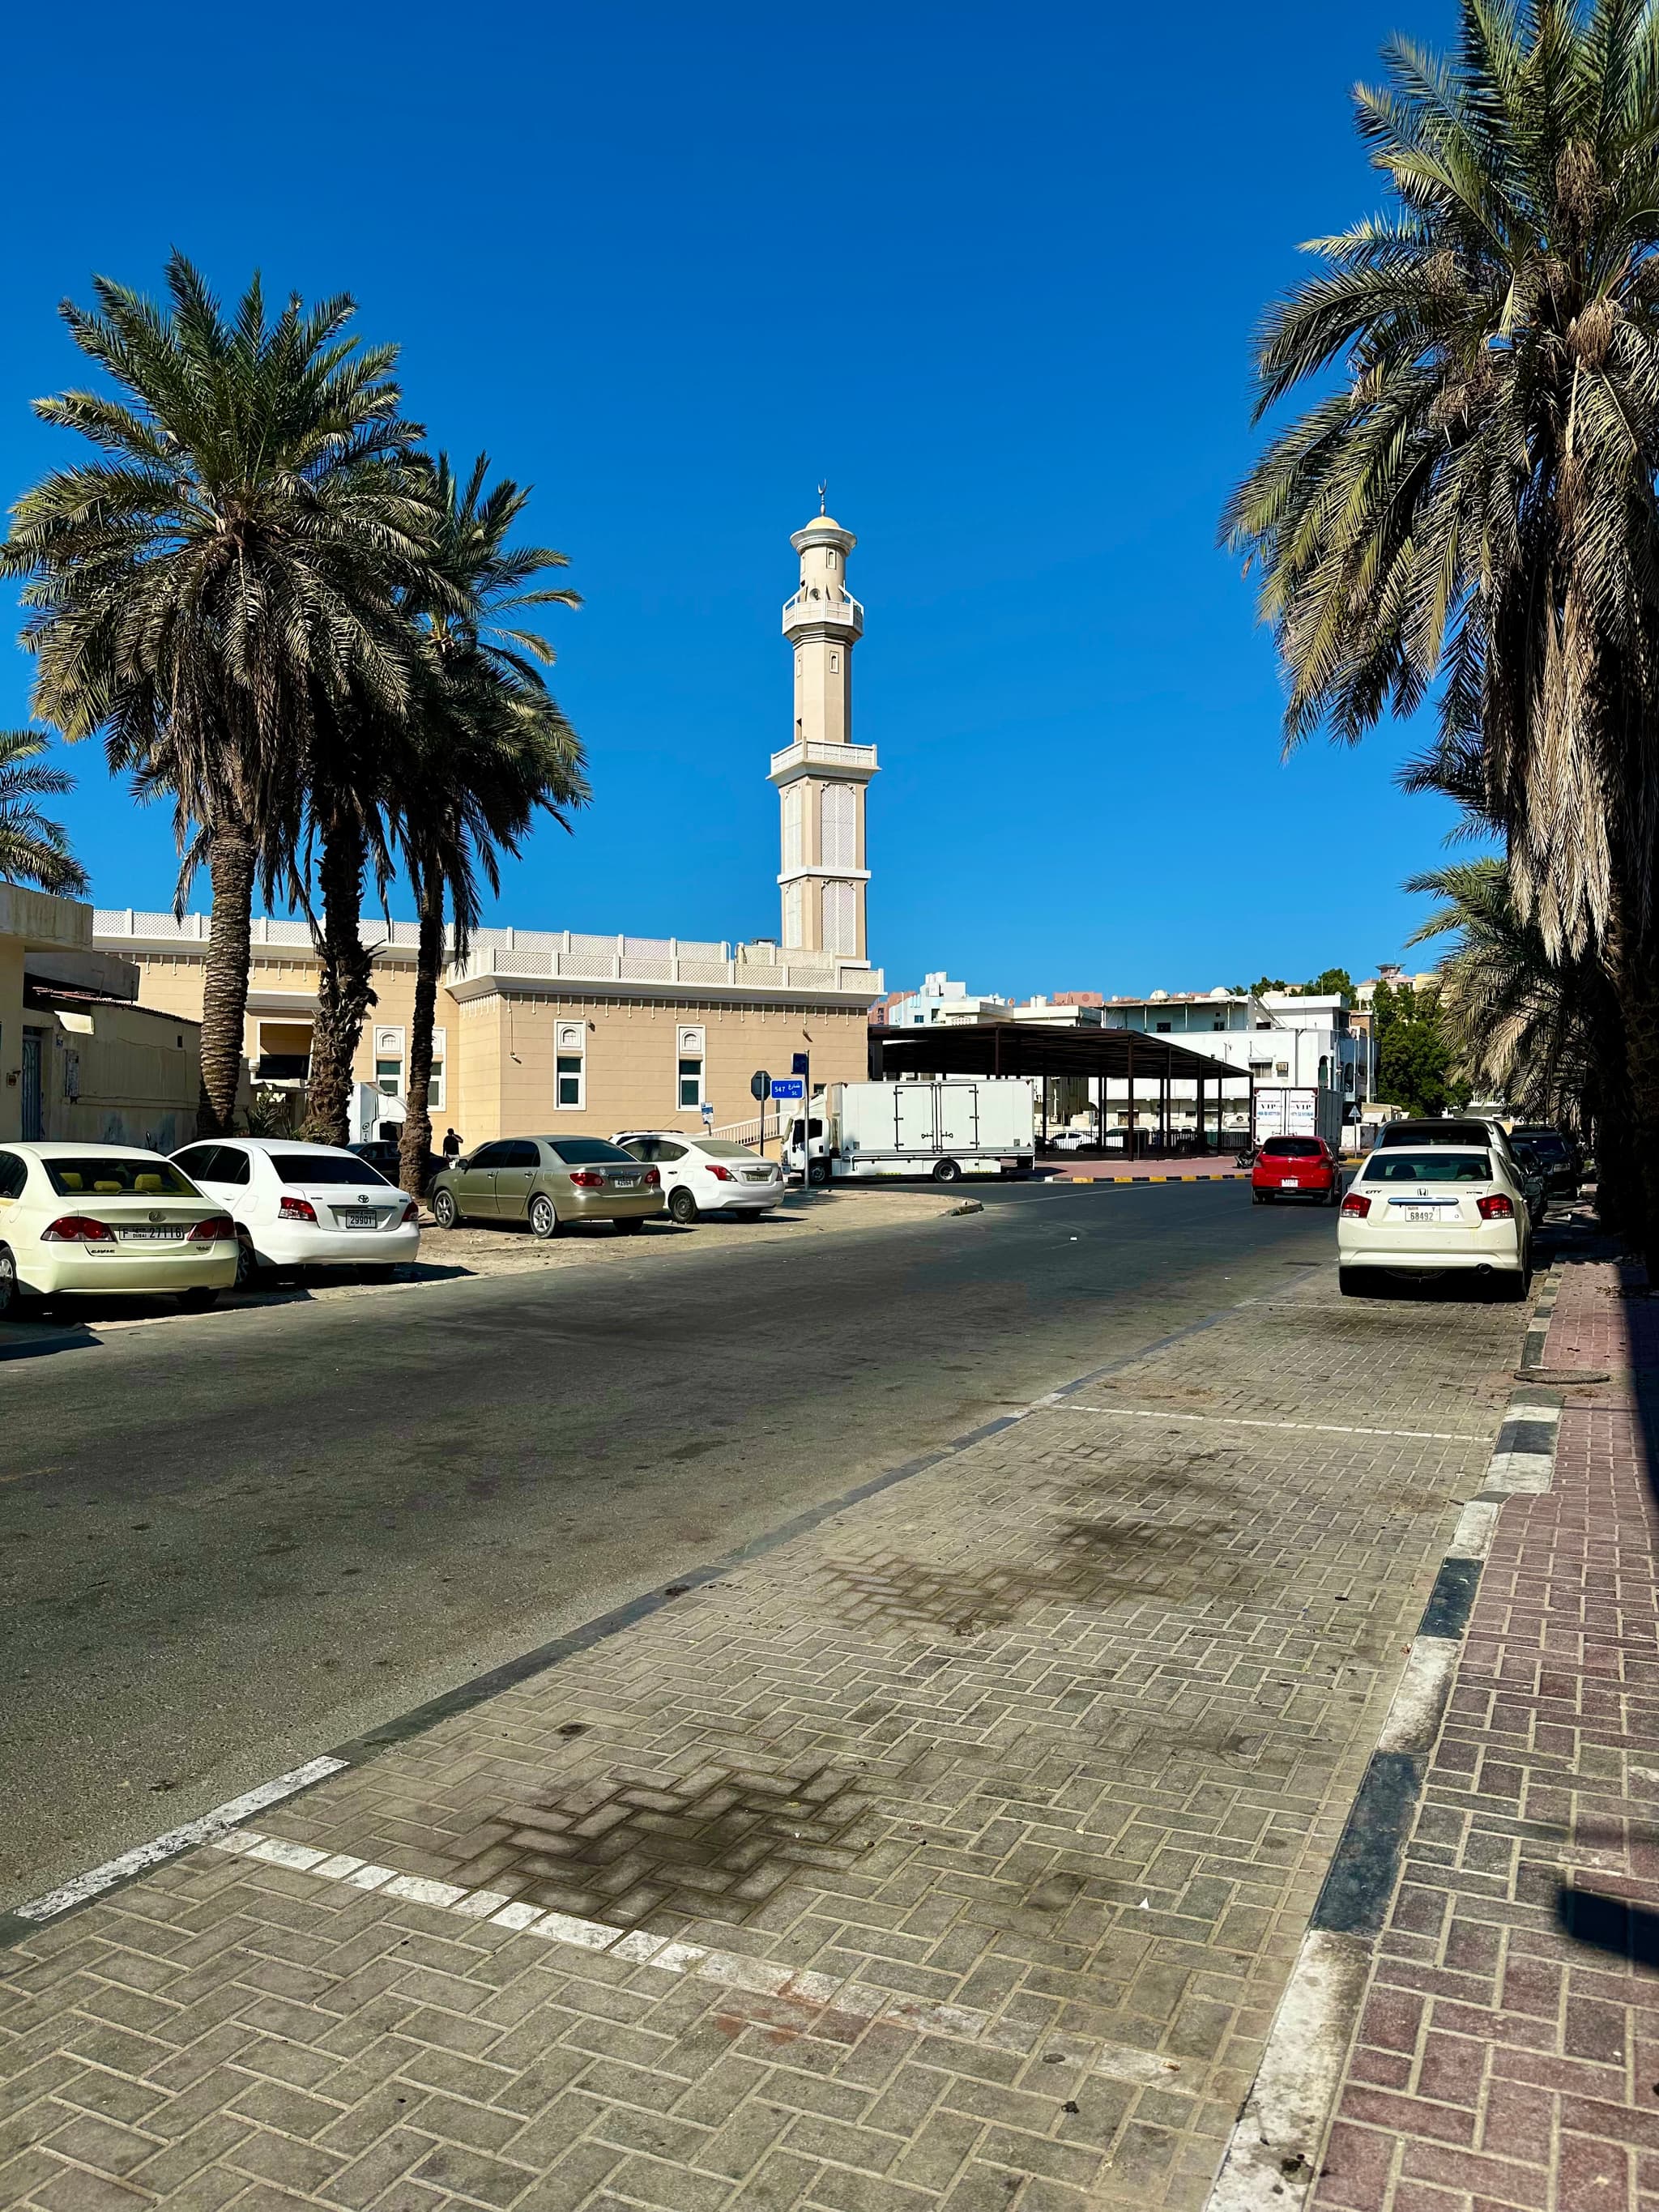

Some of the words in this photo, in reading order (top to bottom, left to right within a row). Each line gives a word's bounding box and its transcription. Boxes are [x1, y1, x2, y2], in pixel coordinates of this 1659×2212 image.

[350, 1216, 373, 1225] 29901
[1410, 1212, 1435, 1221] 68492
[122, 1227, 130, 1238] F
[149, 1227, 182, 1238] 27116
